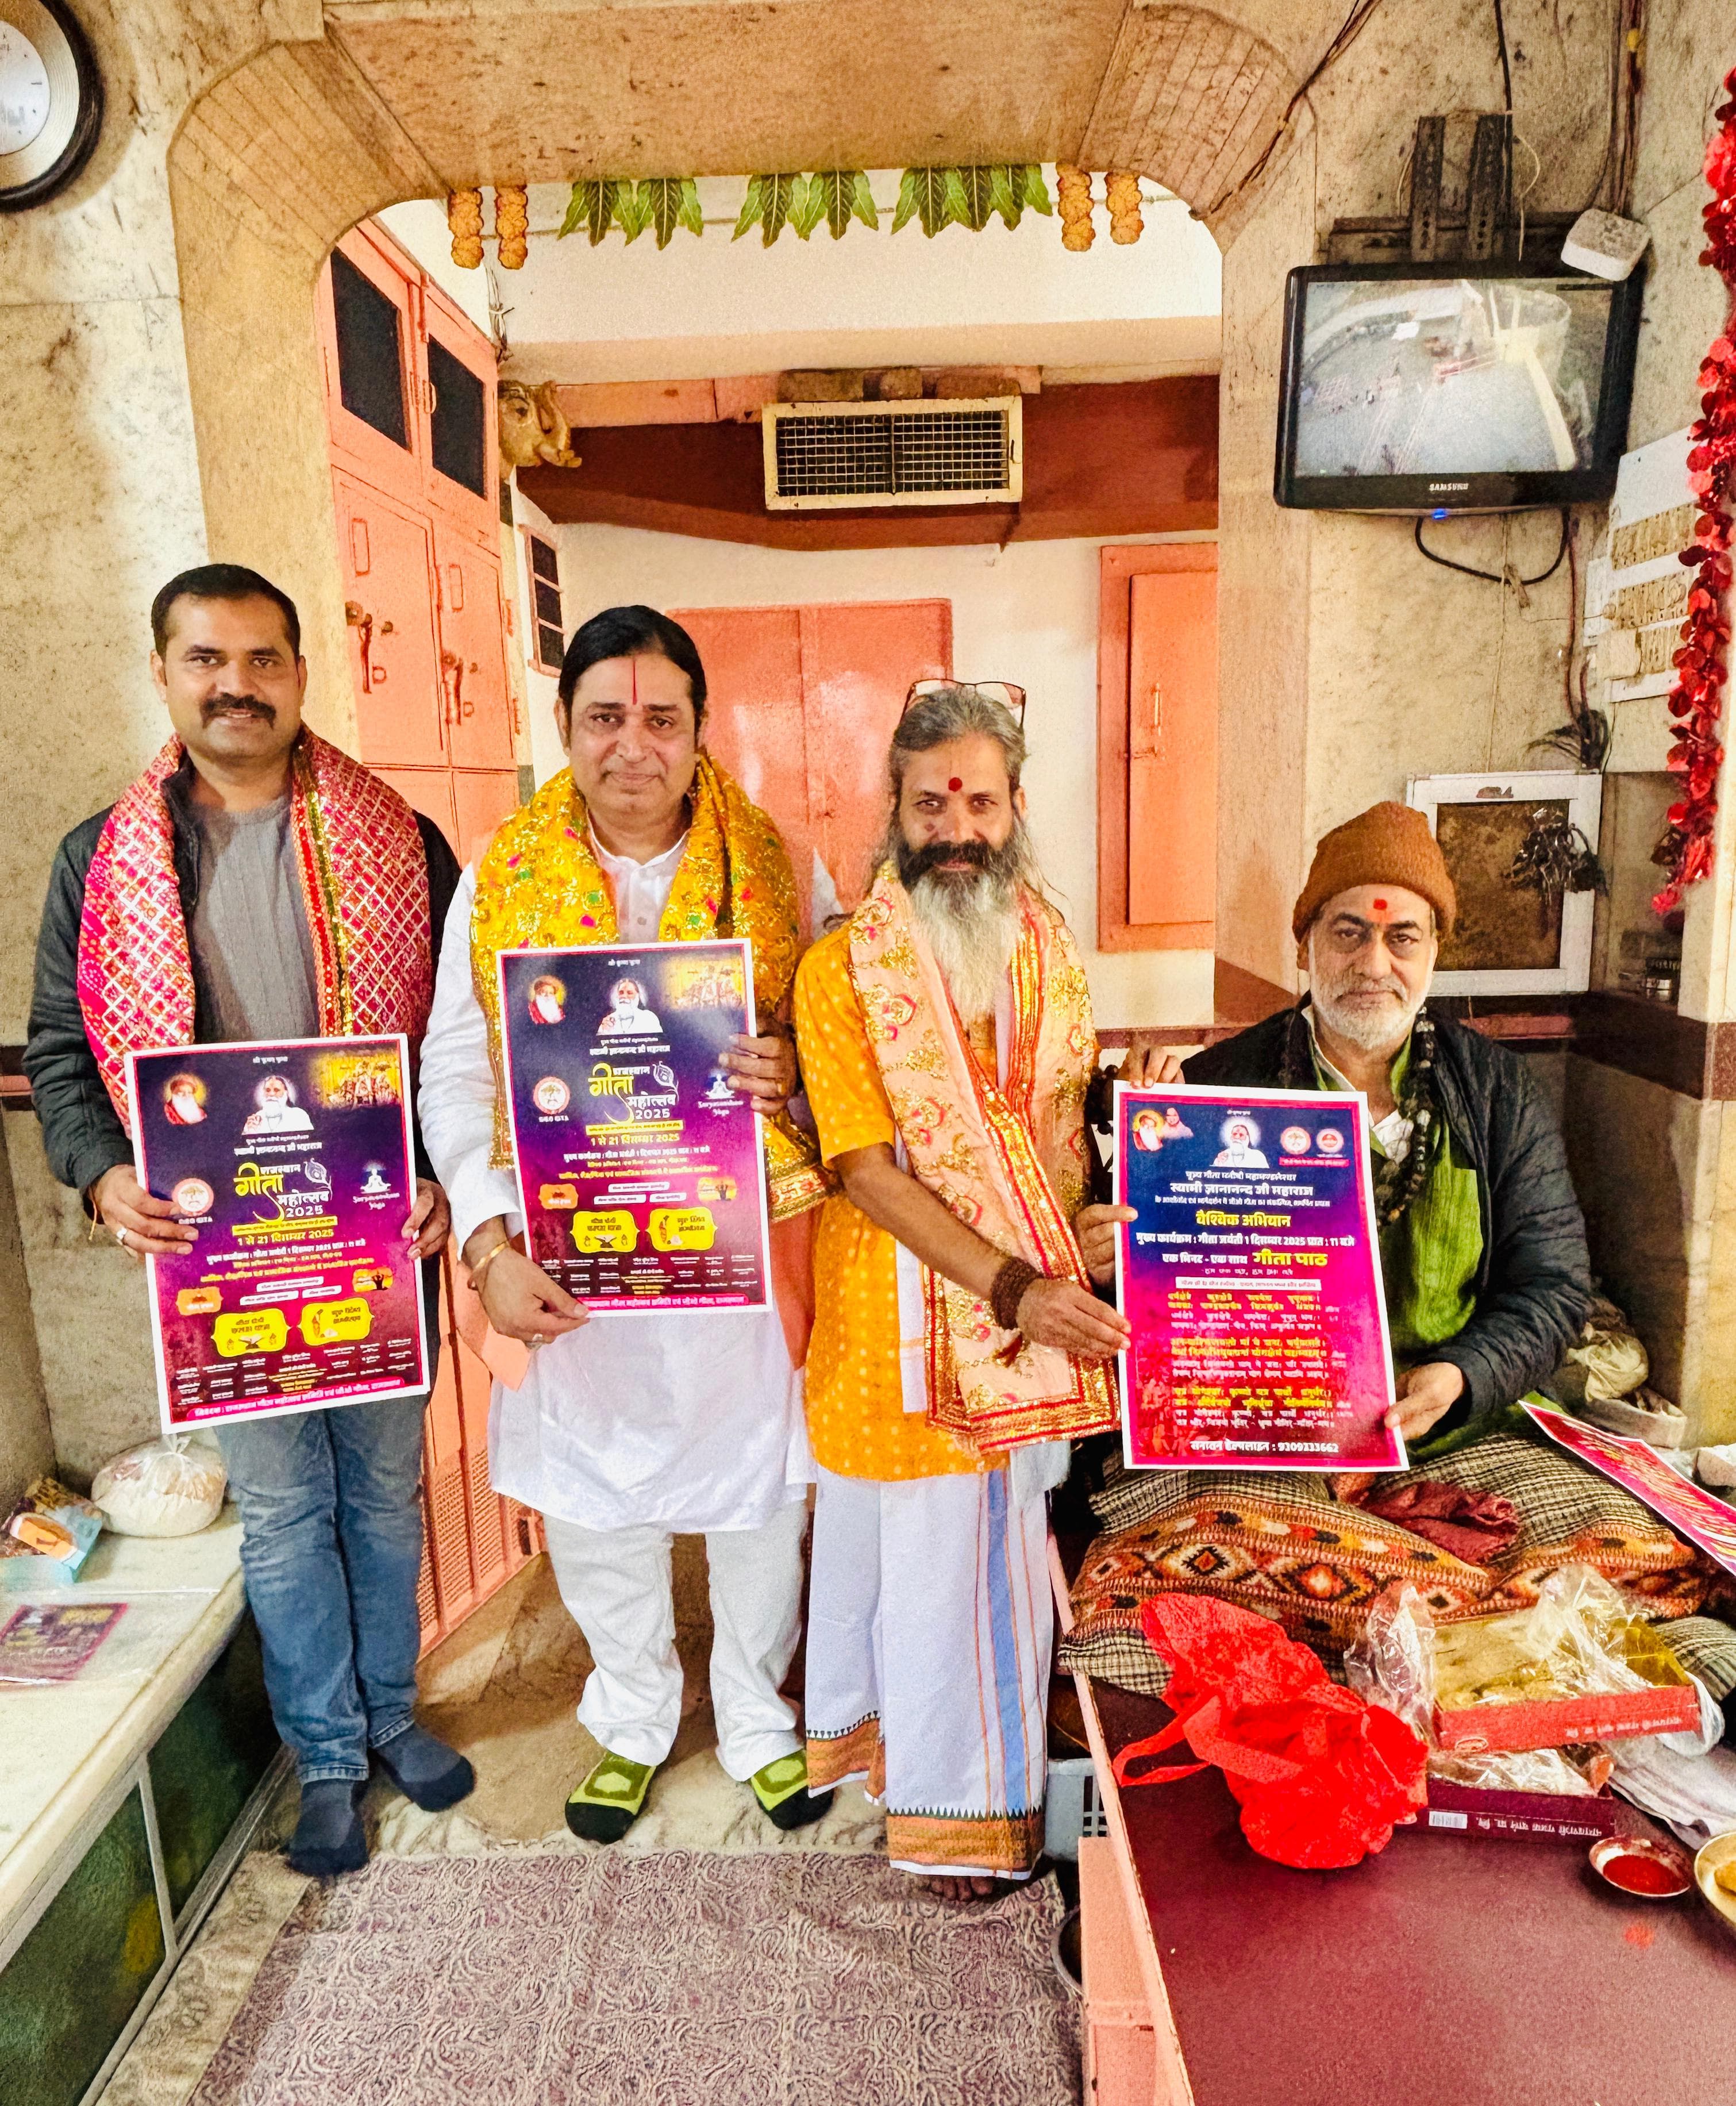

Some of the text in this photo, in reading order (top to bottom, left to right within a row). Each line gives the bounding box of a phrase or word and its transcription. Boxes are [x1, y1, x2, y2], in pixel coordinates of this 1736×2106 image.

[1429, 483, 1469, 491] SAMSUNG
[626, 1091, 676, 1109] महोत्सव
[635, 1109, 671, 1120] 2025
[591, 1137, 595, 1146] 1
[598, 1135, 606, 1145] से
[609, 1136, 618, 1145] 21
[1170, 1181, 1314, 1197] स्वामी ज्ञानानन्द जी महाराज
[276, 1189, 329, 1208] महोत्सव
[286, 1205, 324, 1218] 2025
[1196, 1209, 1291, 1227] वैश्विक अभियान
[245, 1235, 255, 1245] से
[257, 1235, 268, 1244] 21
[1136, 1232, 1156, 1246] मुख्य
[1157, 1231, 1192, 1243] कार्यक्रम
[1198, 1232, 1218, 1244] गीता
[1219, 1233, 1243, 1245] जयंती
[1250, 1233, 1282, 1246] दिसम्बर
[1283, 1237, 1306, 1246] 2025
[1162, 1253, 1178, 1263] एक
[1180, 1252, 1203, 1263] मिनट
[1210, 1254, 1227, 1265] एक
[1252, 1248, 1292, 1266] गीता
[1294, 1252, 1329, 1266] पाठ
[1224, 1438, 1269, 1451] हेल्पलाइन
